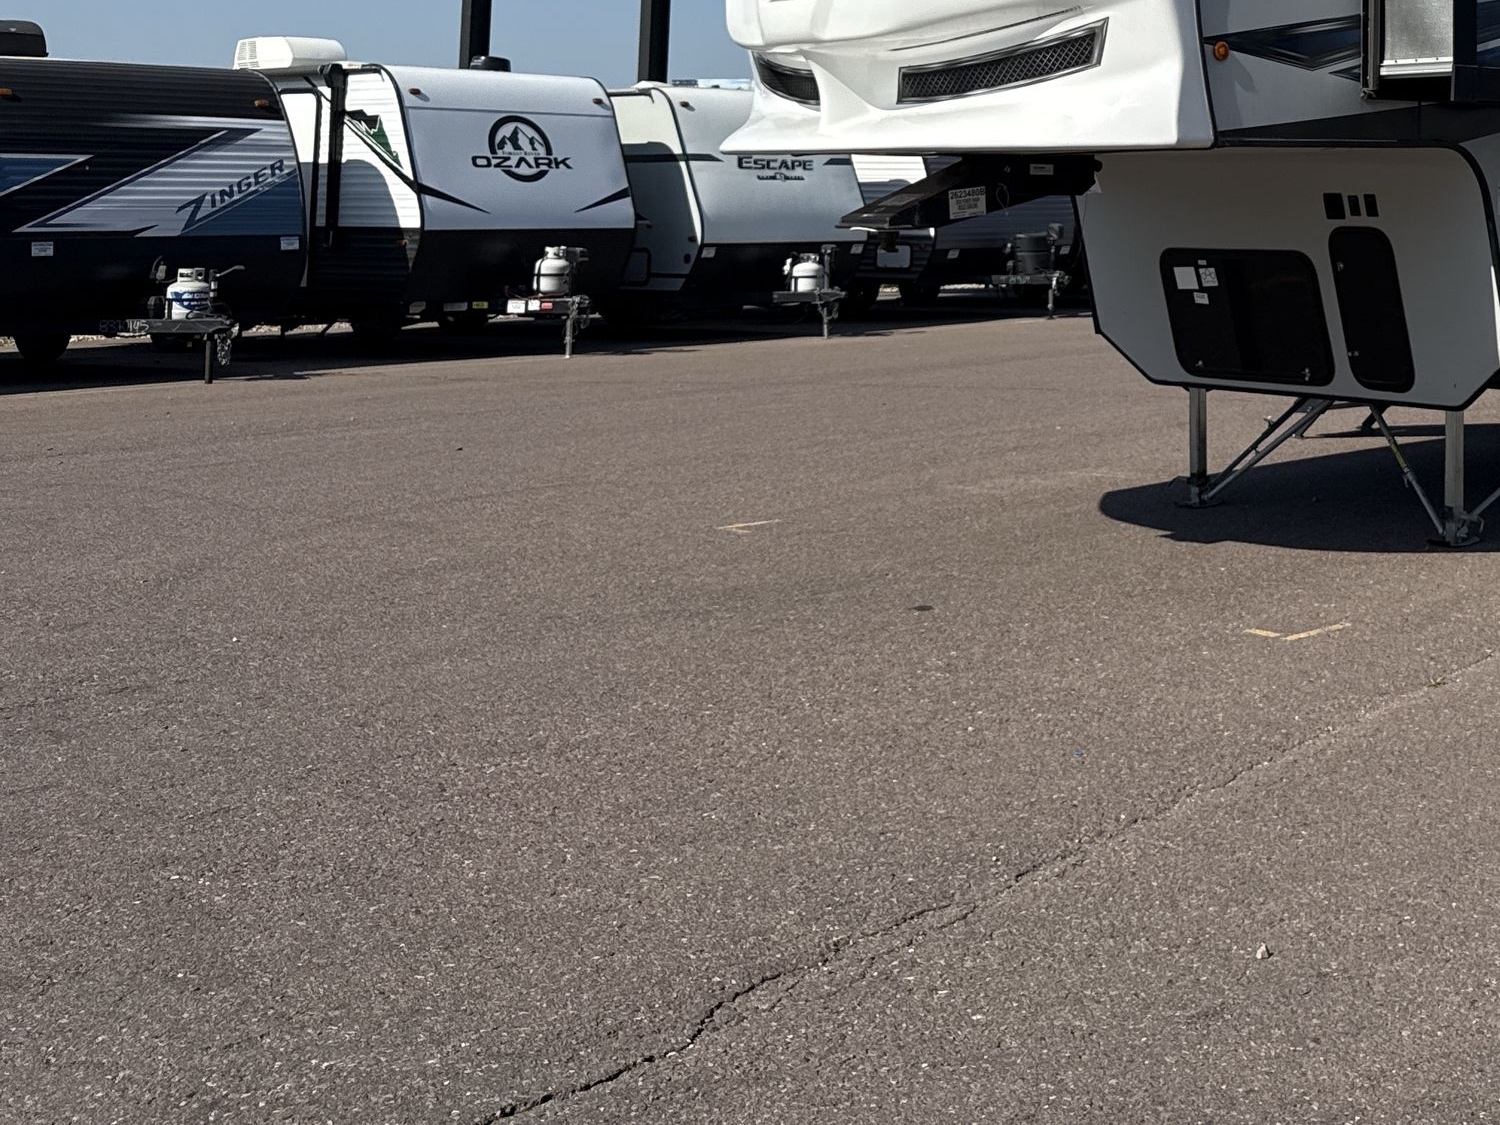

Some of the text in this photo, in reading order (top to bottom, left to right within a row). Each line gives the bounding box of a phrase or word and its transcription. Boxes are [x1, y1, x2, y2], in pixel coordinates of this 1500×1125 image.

[471, 155, 574, 170] OZARK
[738, 156, 814, 171] ESCAPE
[175, 159, 285, 234] ZINGER
